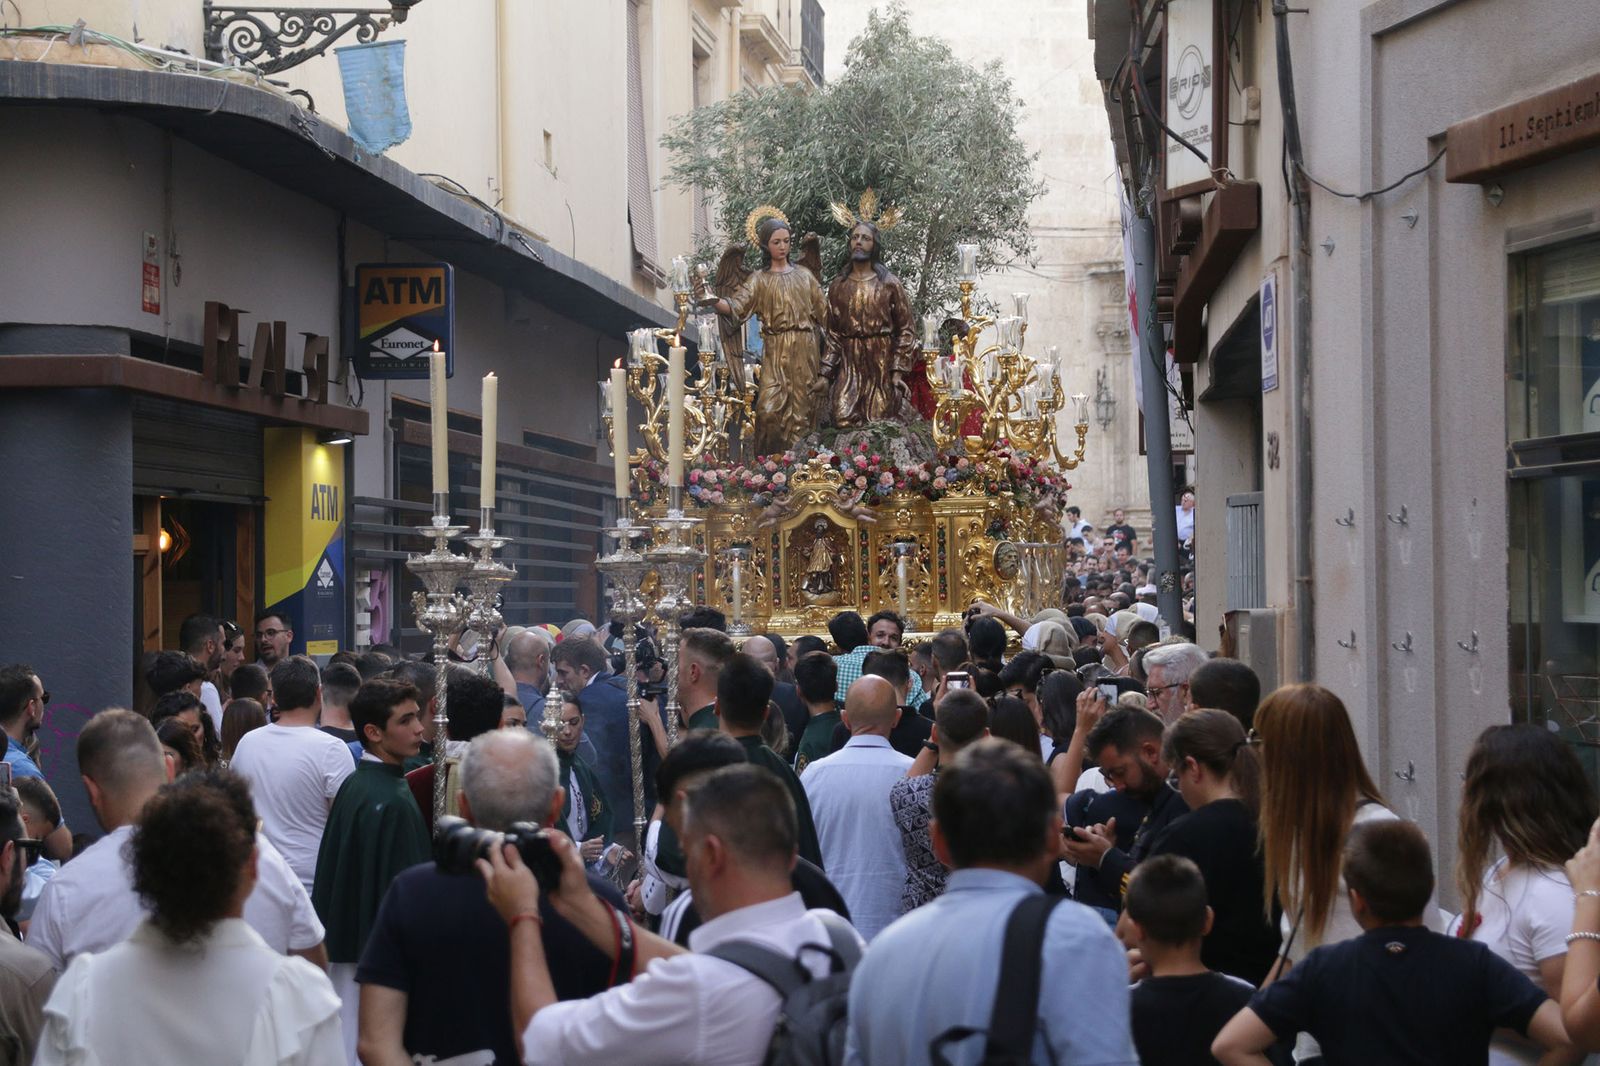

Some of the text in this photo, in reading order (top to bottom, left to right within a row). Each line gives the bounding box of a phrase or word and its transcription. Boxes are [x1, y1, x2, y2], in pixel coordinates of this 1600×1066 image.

[364, 276, 442, 305] ATM
[381, 339, 424, 350] Euronet
[370, 361, 430, 369] WORLDWID
[311, 483, 339, 522] ATM
